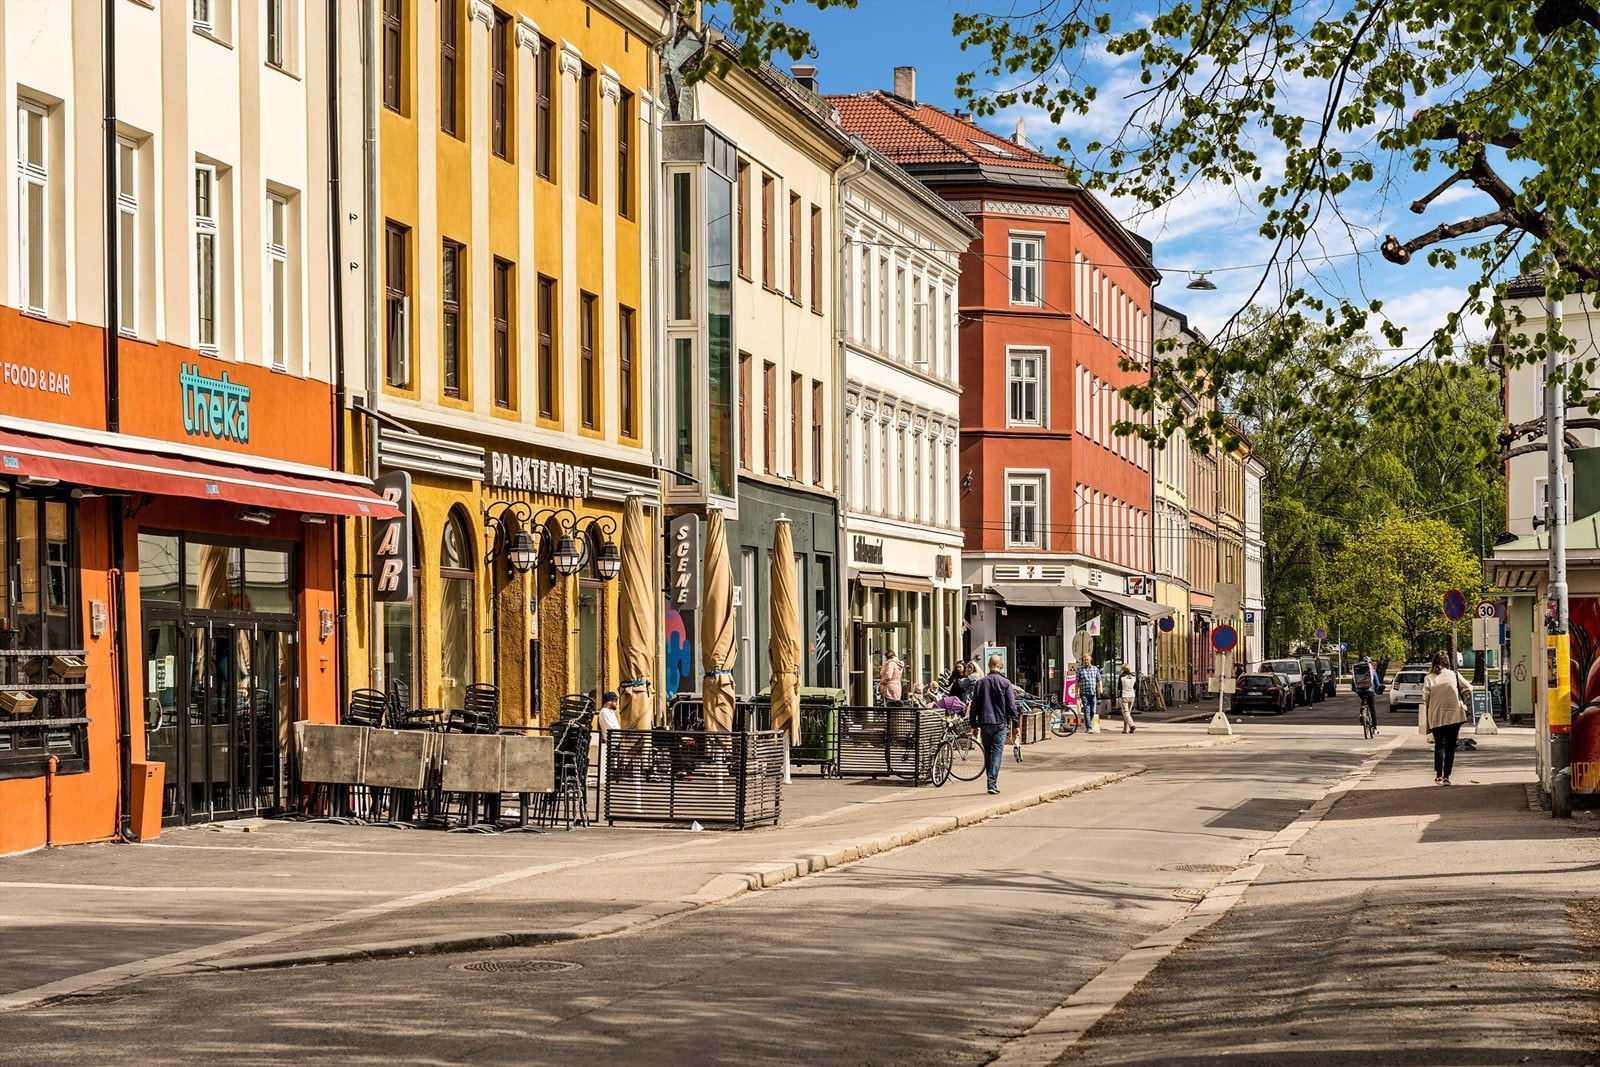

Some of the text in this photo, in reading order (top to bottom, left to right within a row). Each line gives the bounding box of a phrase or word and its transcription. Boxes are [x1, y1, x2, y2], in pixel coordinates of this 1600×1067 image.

[4, 362, 71, 396] FOOD & BAR
[491, 451, 589, 499] PARKTEATRET
[675, 525, 692, 603] SCENE
[1246, 613, 1252, 622] P
[1480, 605, 1494, 617] 30
